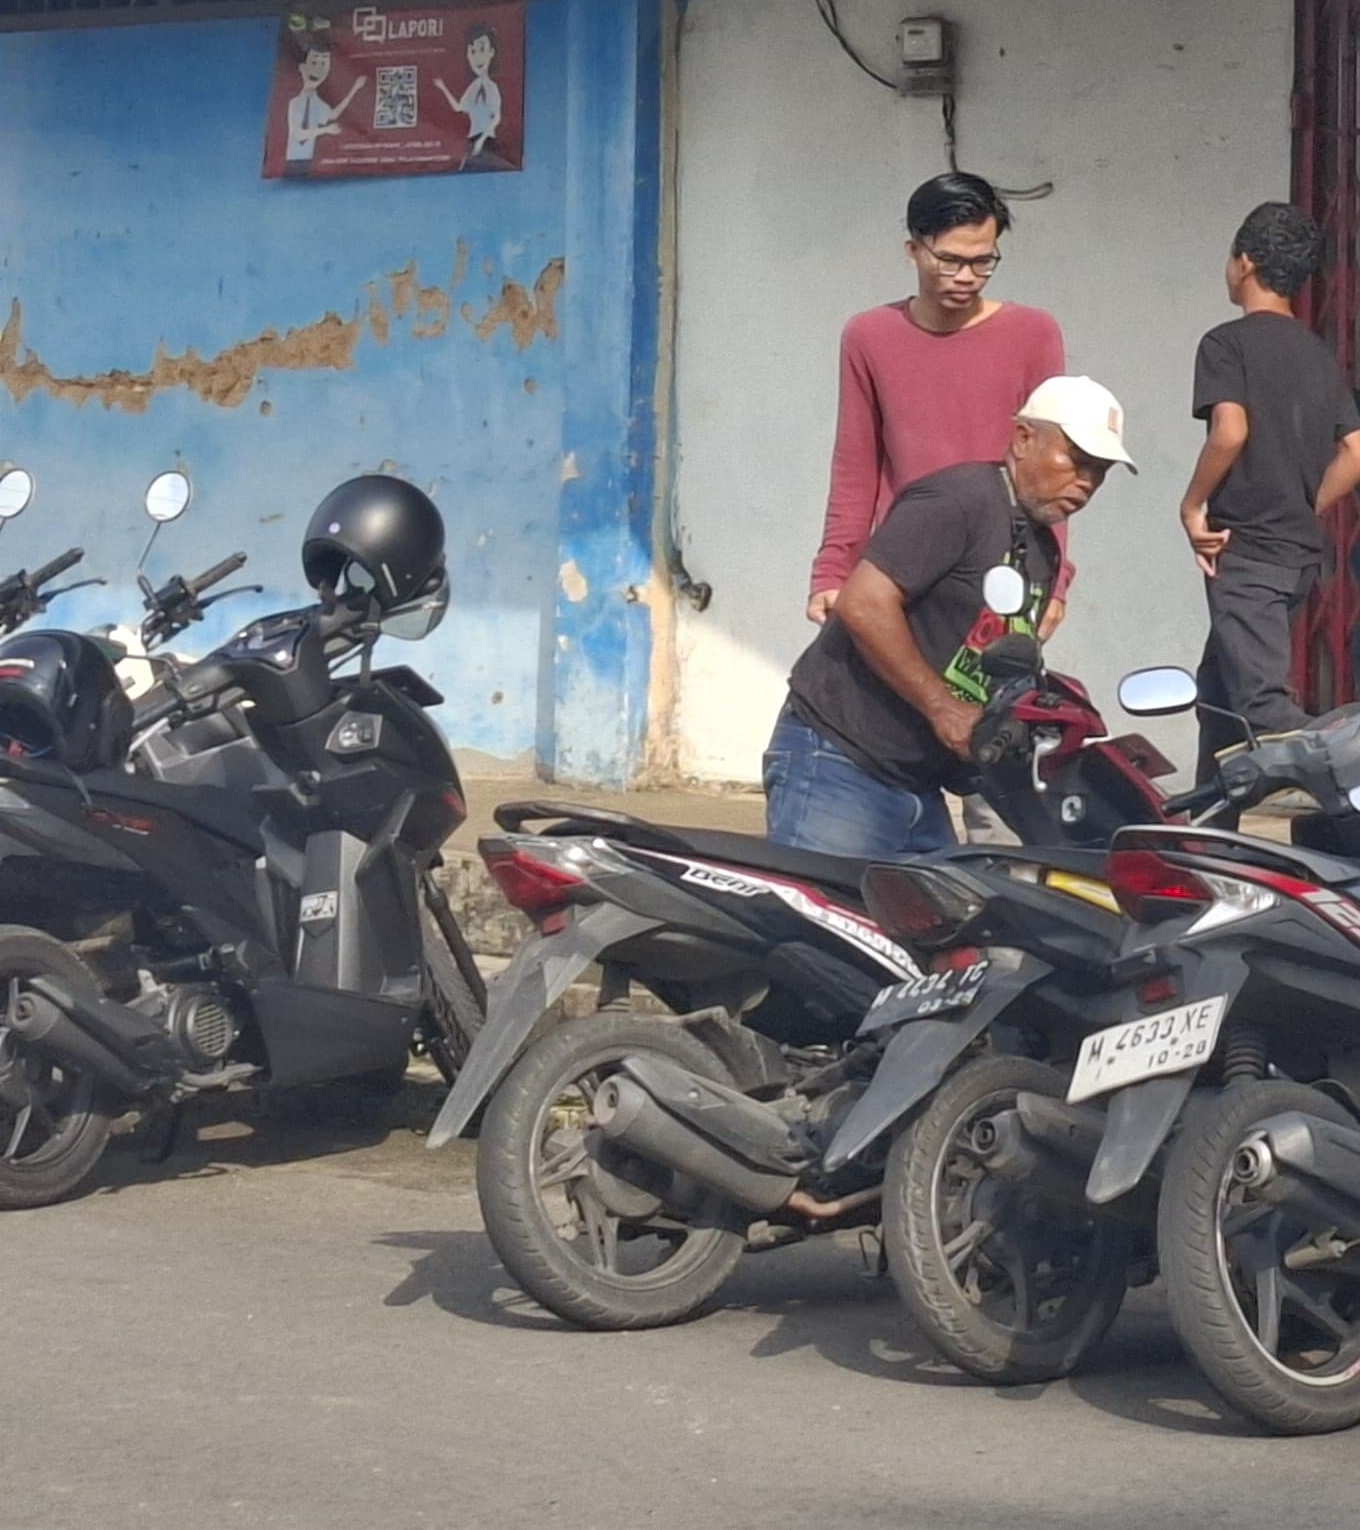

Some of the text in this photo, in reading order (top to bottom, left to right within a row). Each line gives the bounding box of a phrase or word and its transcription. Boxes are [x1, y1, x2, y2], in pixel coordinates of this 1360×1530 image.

[1087, 1004, 1213, 1065] M 4633 XE
